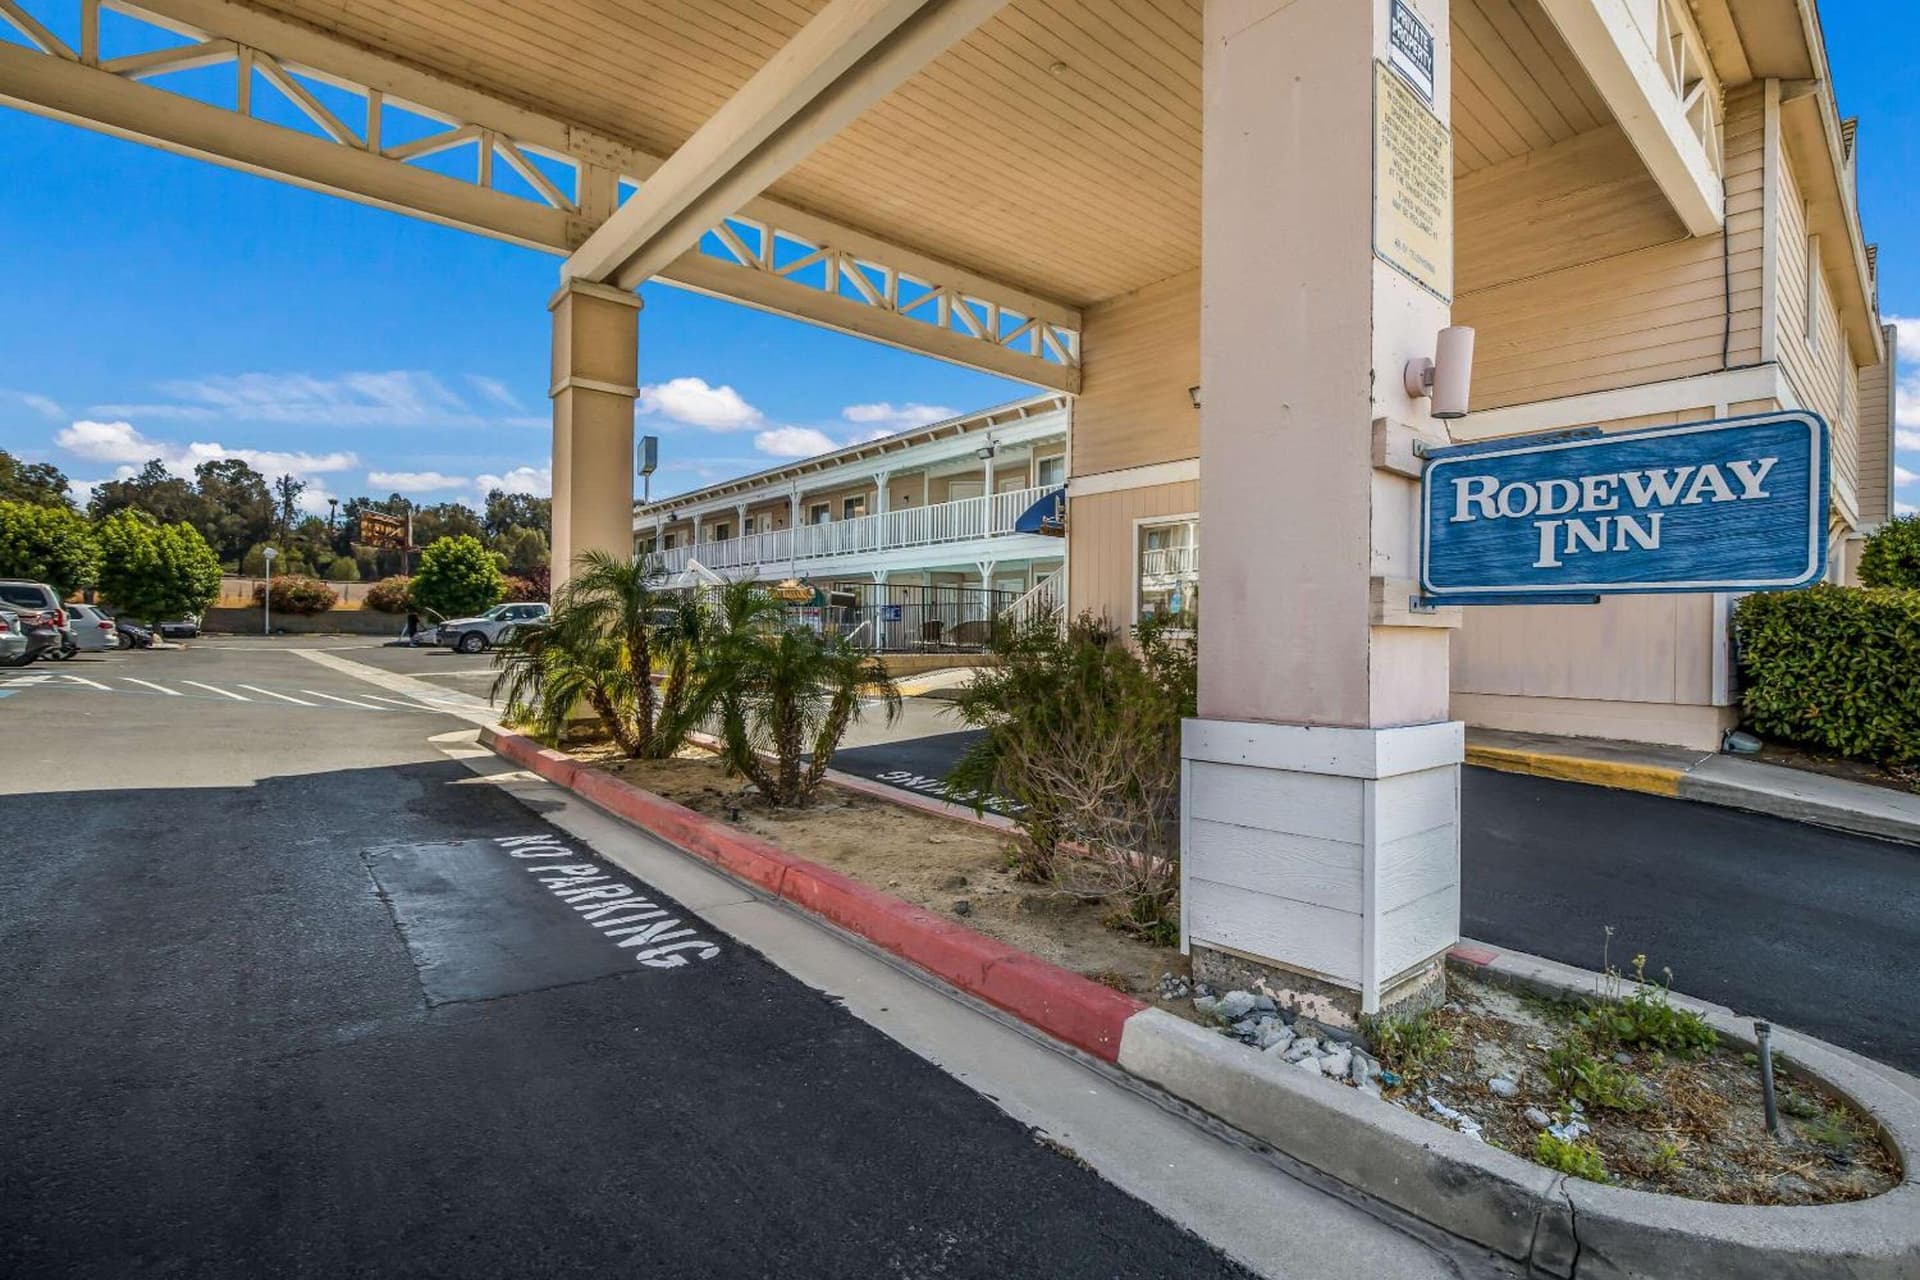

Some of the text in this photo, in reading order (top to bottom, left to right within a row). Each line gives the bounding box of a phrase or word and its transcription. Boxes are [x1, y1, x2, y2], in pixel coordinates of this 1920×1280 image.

[1392, 17, 1432, 71] PROPERTY
[1396, 4, 1429, 51] PRIVATE
[1450, 457, 1778, 522] RODEWAY
[1532, 512, 1664, 568] INN
[493, 834, 721, 969] NO PARKING
